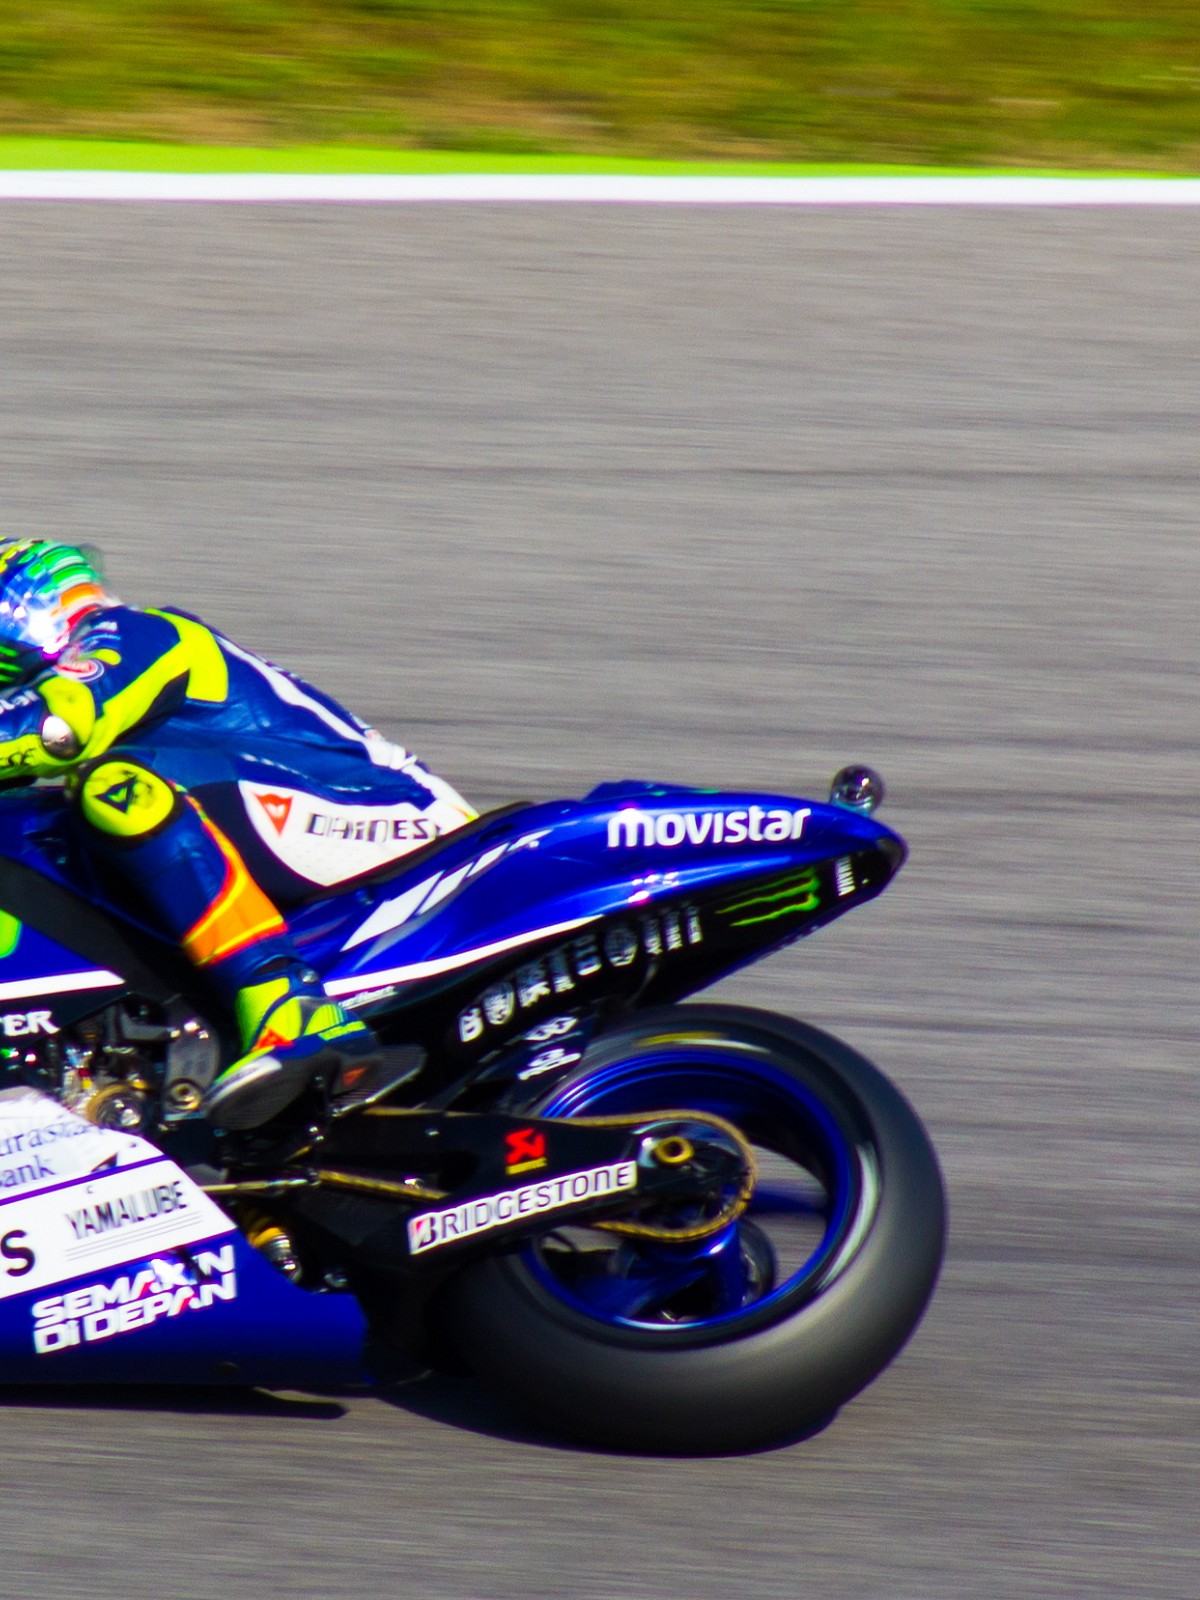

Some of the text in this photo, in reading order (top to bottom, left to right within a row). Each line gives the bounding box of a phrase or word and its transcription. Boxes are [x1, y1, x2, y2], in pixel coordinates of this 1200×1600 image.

[607, 805, 811, 848] movistar
[64, 1180, 188, 1239] YAMALUBE
[411, 1164, 631, 1251] BRIDGESTONE
[83, 1271, 237, 1341] DEPAN
